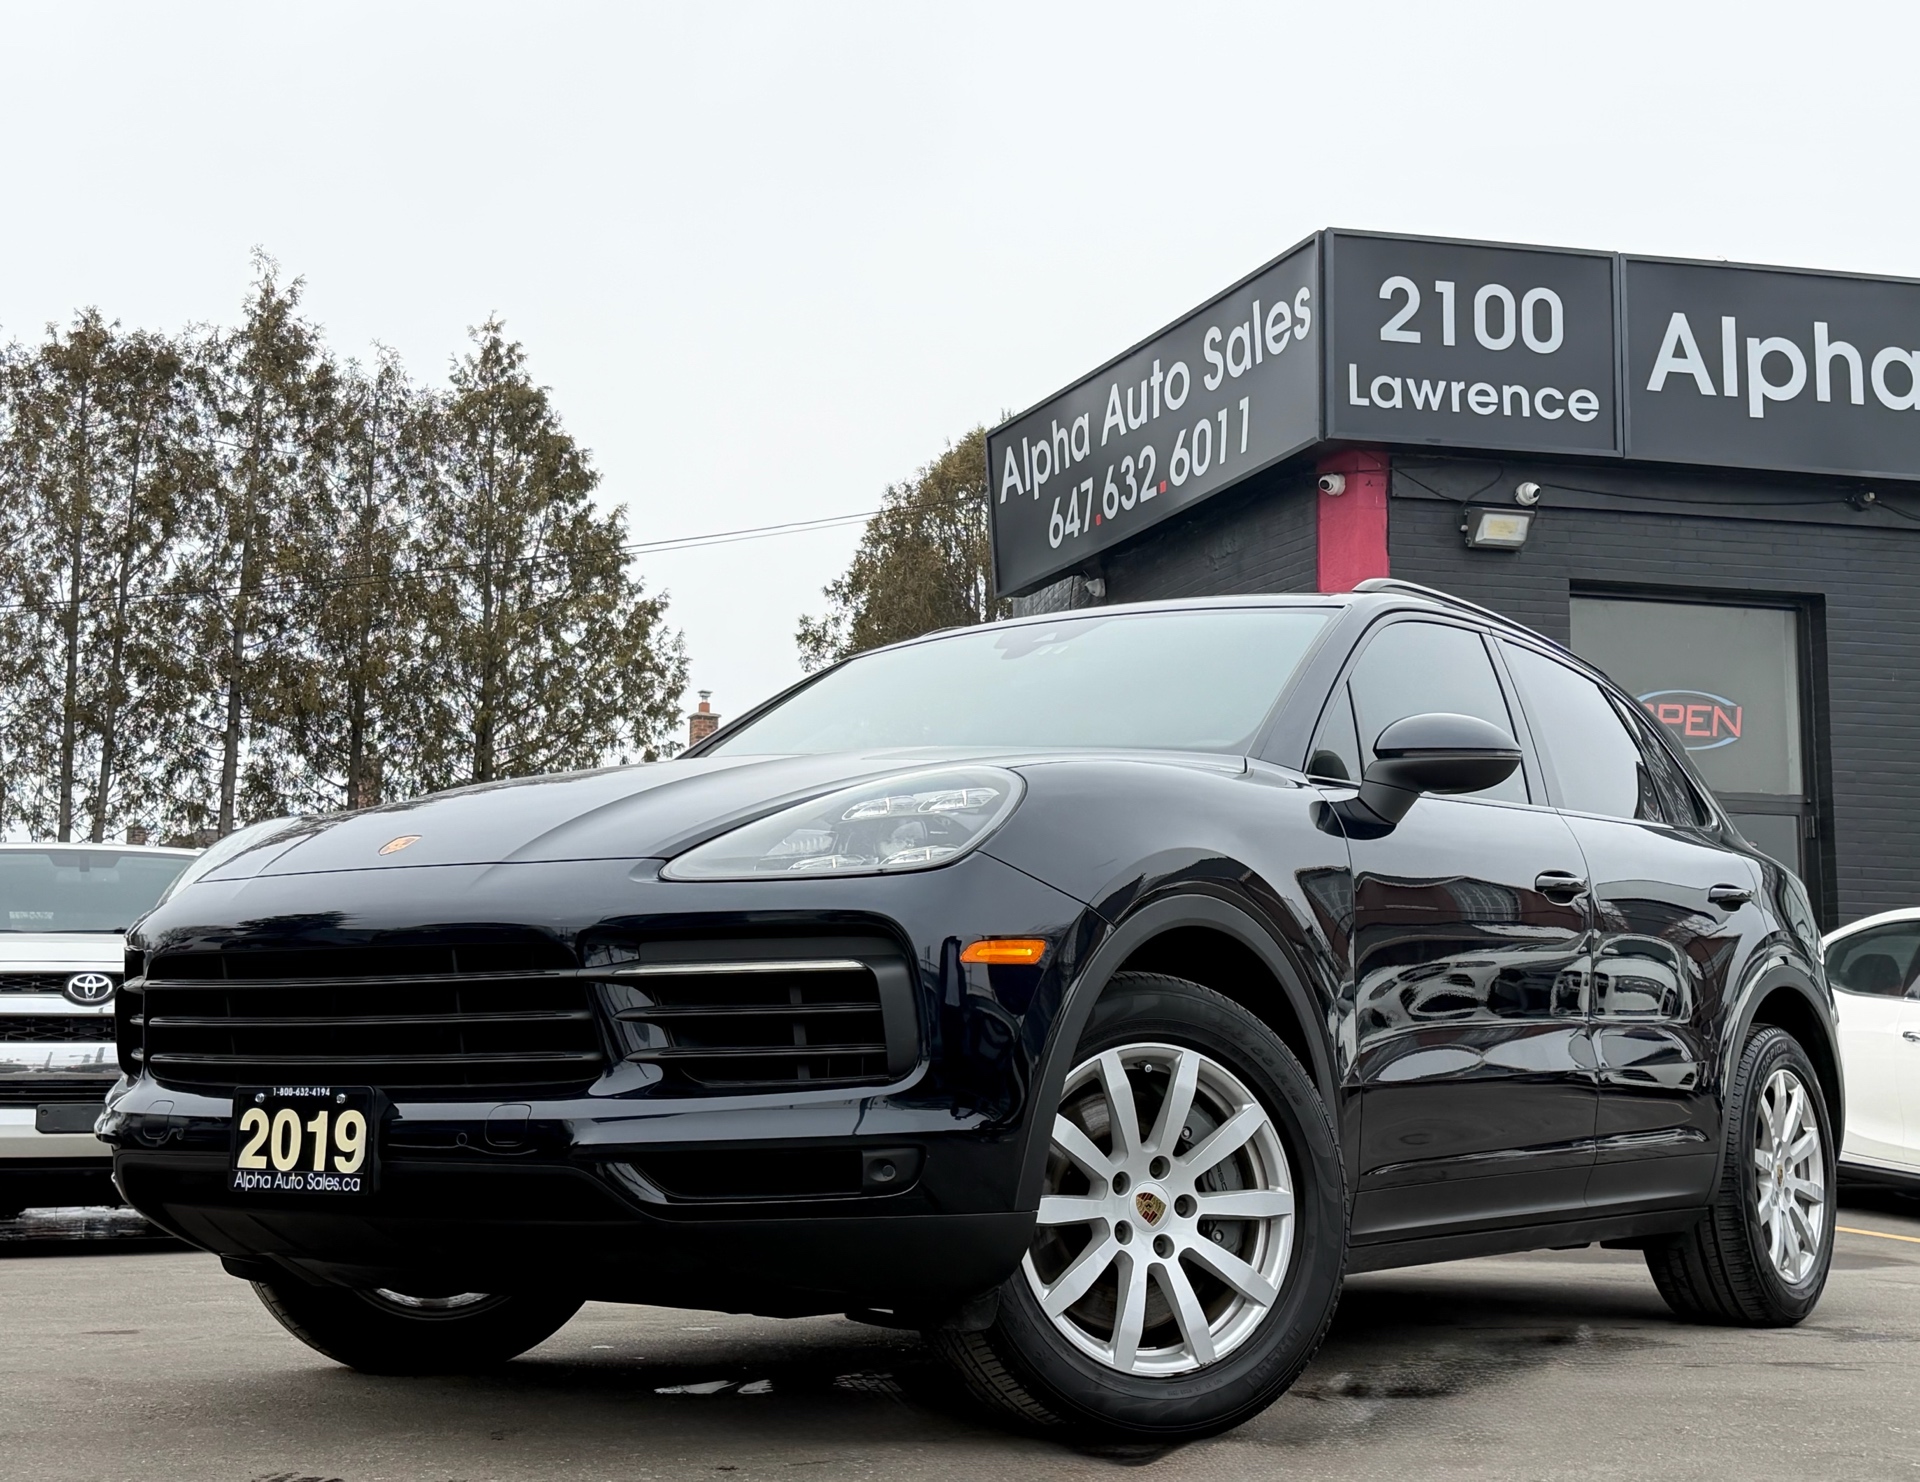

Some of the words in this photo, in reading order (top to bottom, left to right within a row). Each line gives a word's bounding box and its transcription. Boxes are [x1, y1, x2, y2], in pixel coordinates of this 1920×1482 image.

[1378, 275, 1564, 355] 2100
[999, 412, 1091, 504] Alpha
[1101, 359, 1190, 447] Auto
[1203, 286, 1312, 392] Sales
[1348, 363, 1600, 423] Lawrence
[1646, 312, 1920, 419] Alpha
[1048, 396, 1250, 549] 647.632.6011
[273, 1087, 331, 1097] 1-800-632-4194
[1754, 1042, 1788, 1095] SCORPION
[237, 1107, 367, 1174] 2019
[233, 1171, 271, 1191] Alpha
[274, 1172, 304, 1190] Auto
[306, 1173, 361, 1192] Sales.ca
